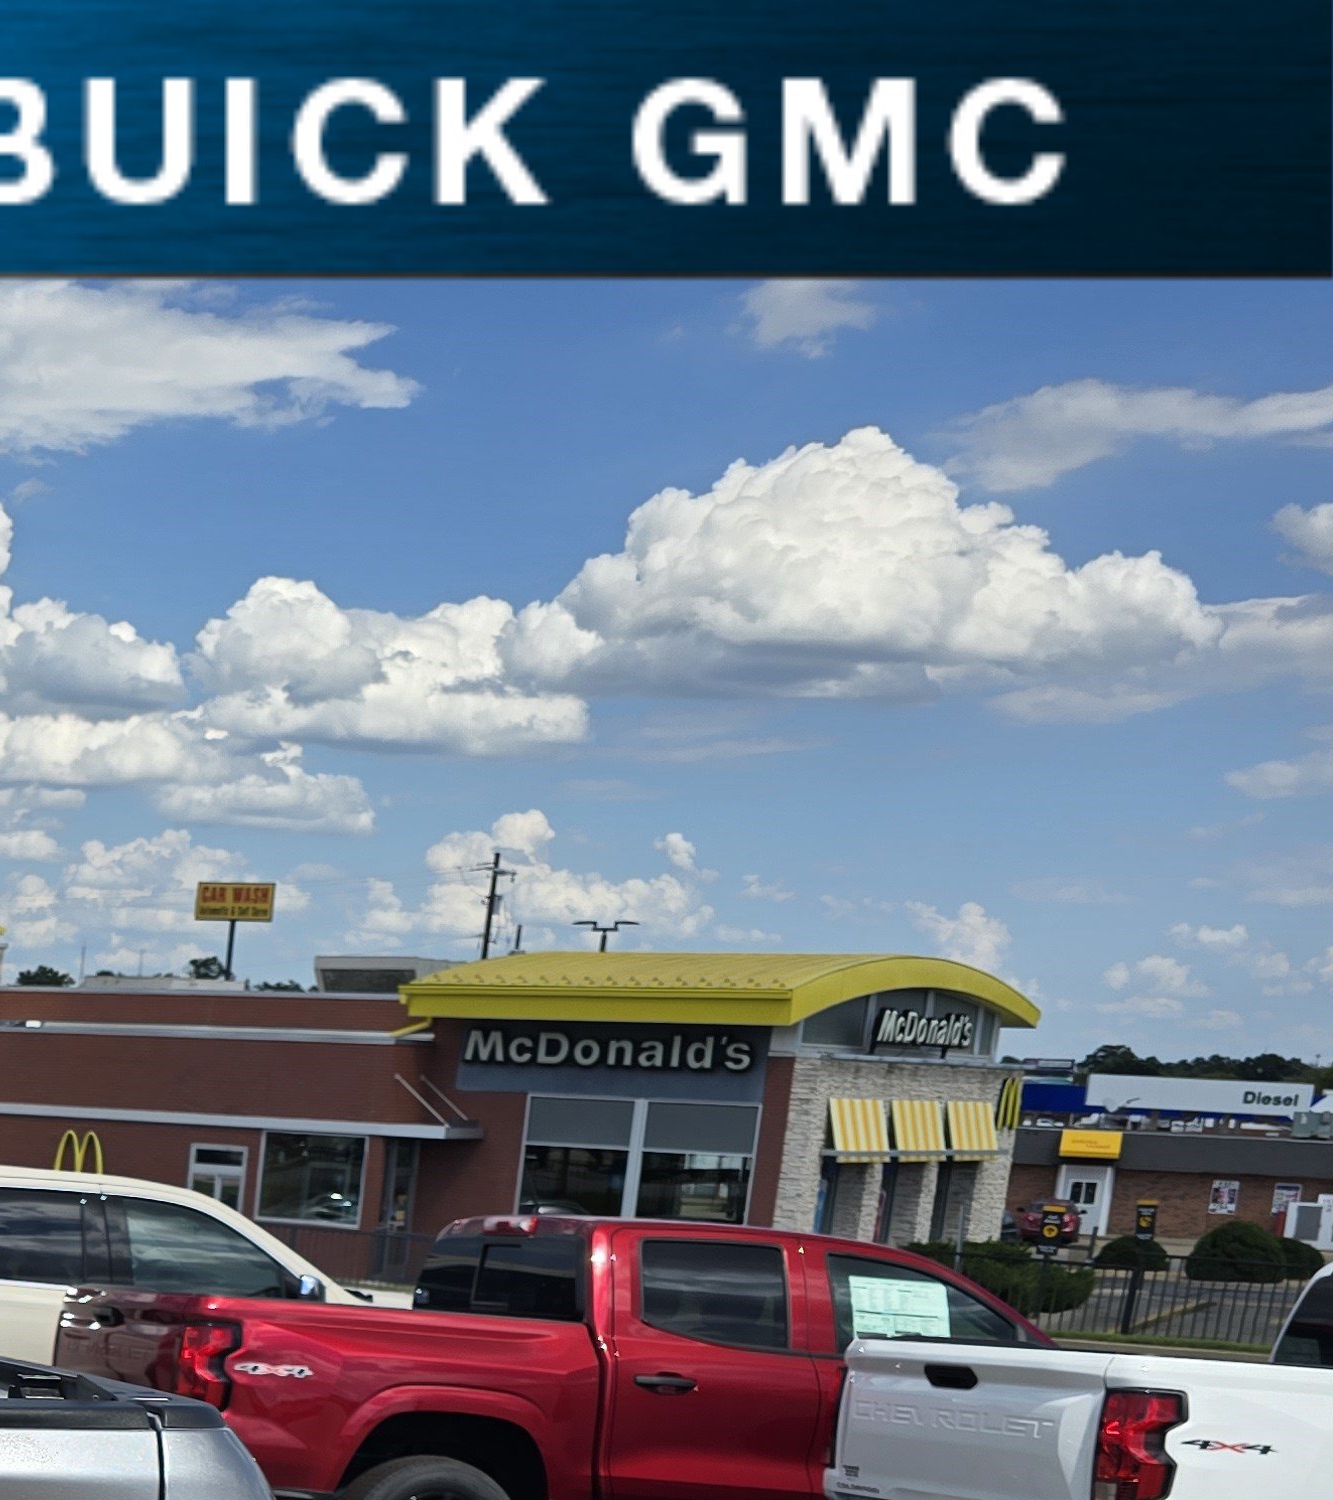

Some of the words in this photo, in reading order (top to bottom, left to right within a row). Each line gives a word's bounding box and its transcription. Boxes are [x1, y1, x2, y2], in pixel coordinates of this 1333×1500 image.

[201, 886, 226, 903] CAR
[234, 886, 270, 904] WASH
[877, 1009, 973, 1047] McDonald's
[463, 1029, 751, 1071] McDonald's
[1242, 1091, 1299, 1107] Diesel
[851, 1398, 1055, 1440] CHEVROLET
